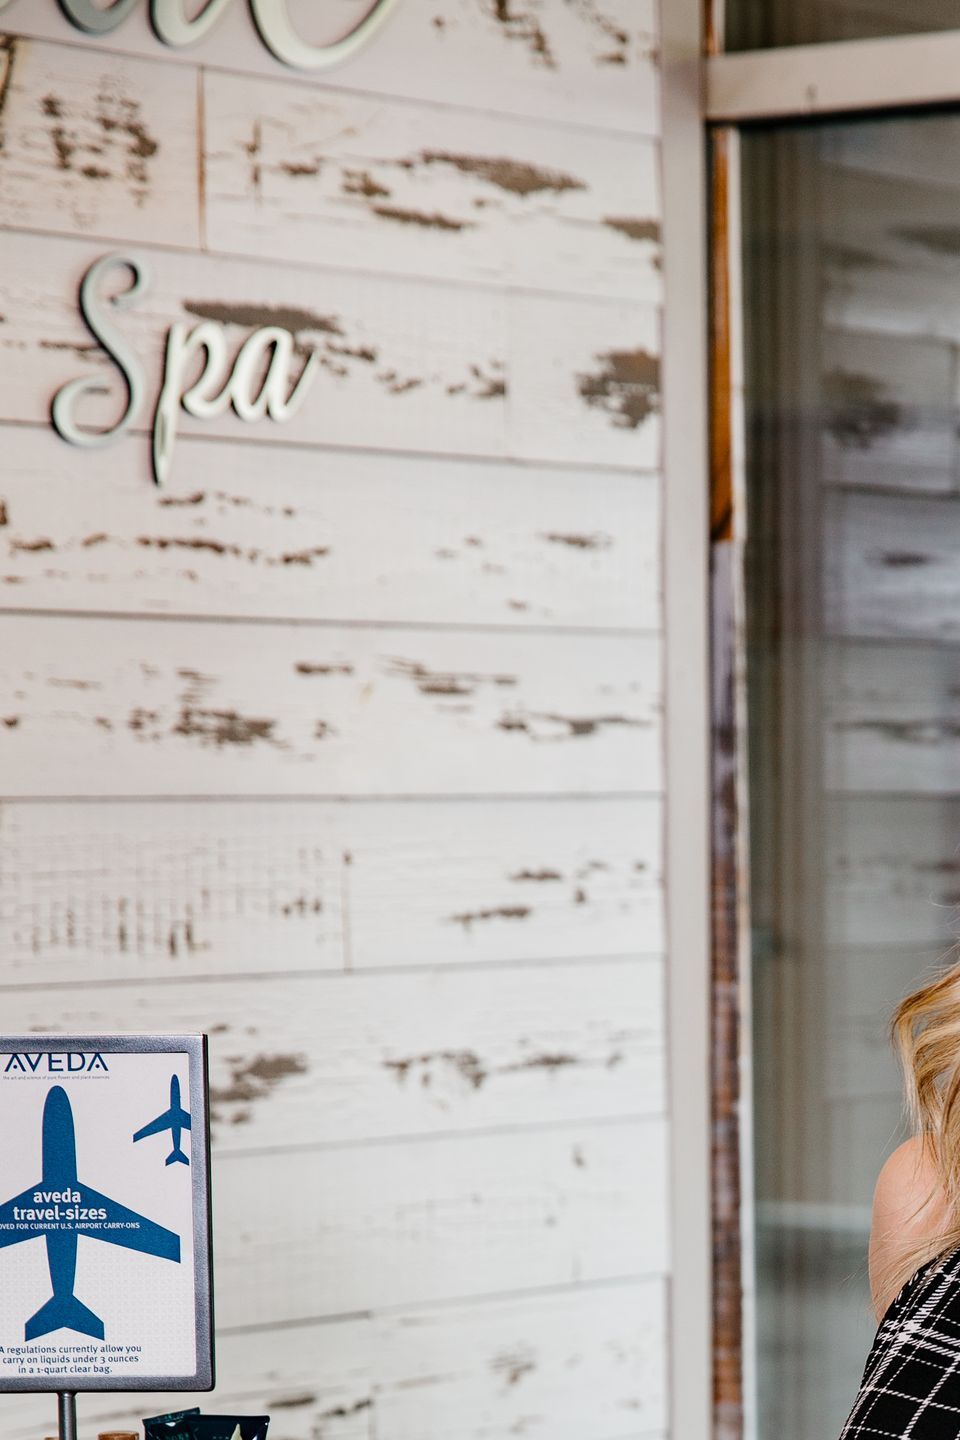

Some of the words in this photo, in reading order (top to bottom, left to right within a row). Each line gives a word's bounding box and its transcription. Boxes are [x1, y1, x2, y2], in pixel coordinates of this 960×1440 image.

[49, 254, 318, 488] Spa
[4, 1053, 109, 1072] AVEDA
[33, 1188, 82, 1203] aveda
[13, 1205, 107, 1221] travel-sizes
[6, 1346, 57, 1356] regulations
[58, 1345, 99, 1355] currently
[100, 1345, 124, 1353] allow
[125, 1346, 142, 1354] you
[26, 1356, 38, 1364] on
[40, 1355, 71, 1365] liquids
[72, 1355, 98, 1363] under
[100, 1356, 107, 1364] 3
[107, 1355, 140, 1363] ounces
[18, 1366, 27, 1374] in
[36, 1366, 68, 1375] 1-quart
[69, 1365, 91, 1373] clear
[93, 1365, 113, 1375] bag.
